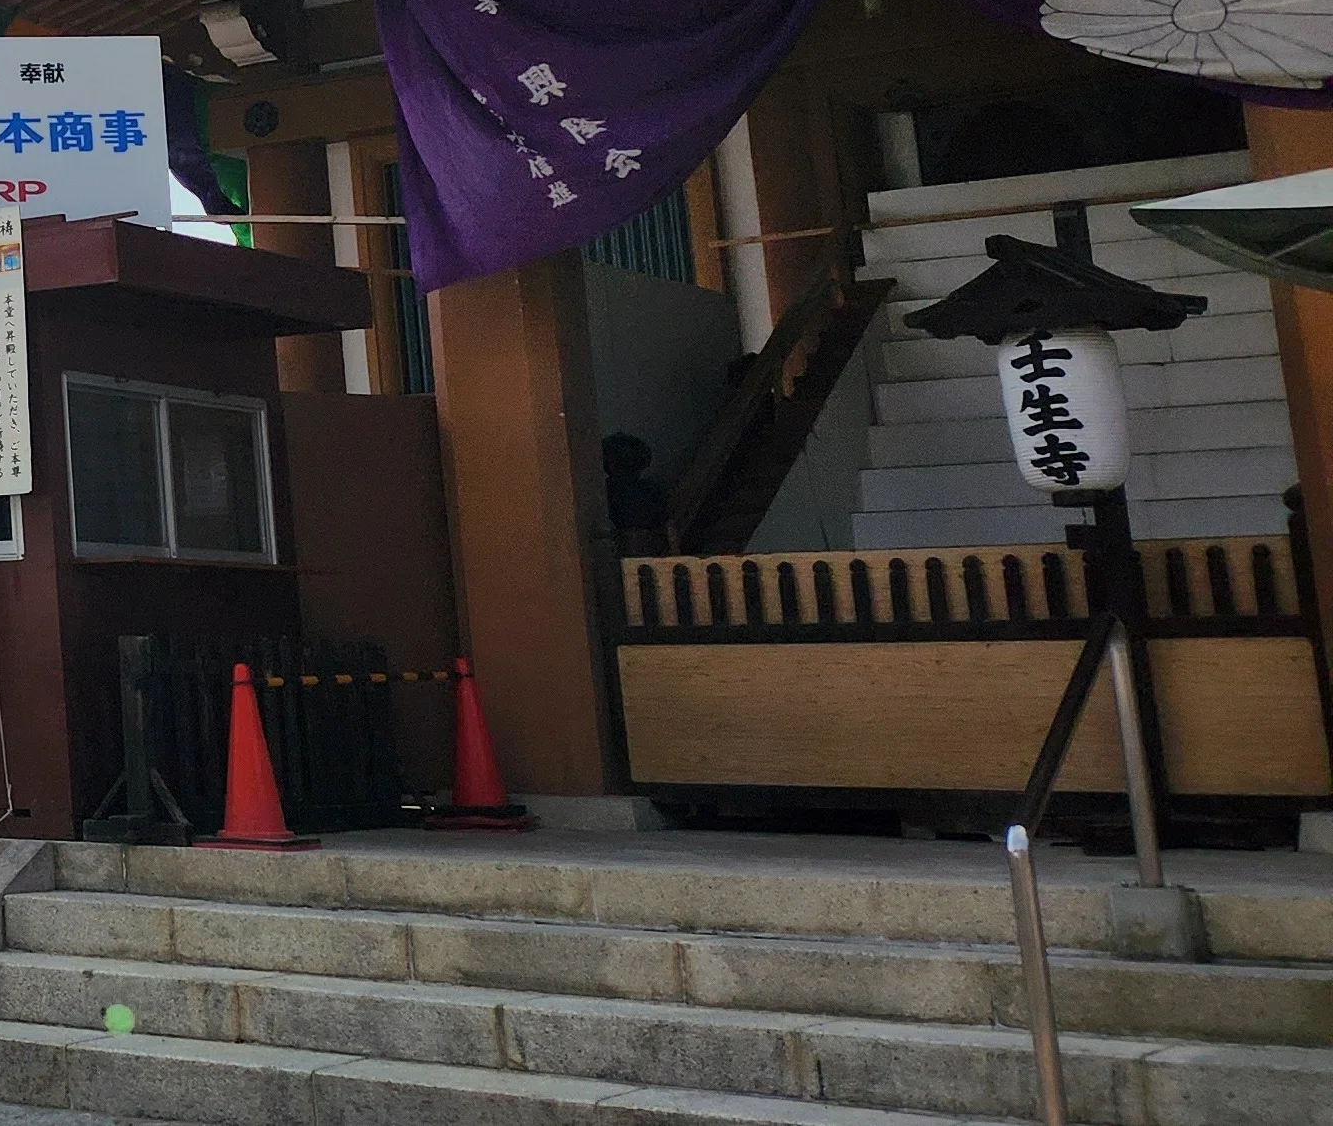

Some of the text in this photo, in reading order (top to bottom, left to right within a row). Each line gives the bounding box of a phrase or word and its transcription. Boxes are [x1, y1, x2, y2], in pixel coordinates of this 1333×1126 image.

[19, 62, 65, 84] 奉献
[1010, 330, 1090, 486] 壬生寺
